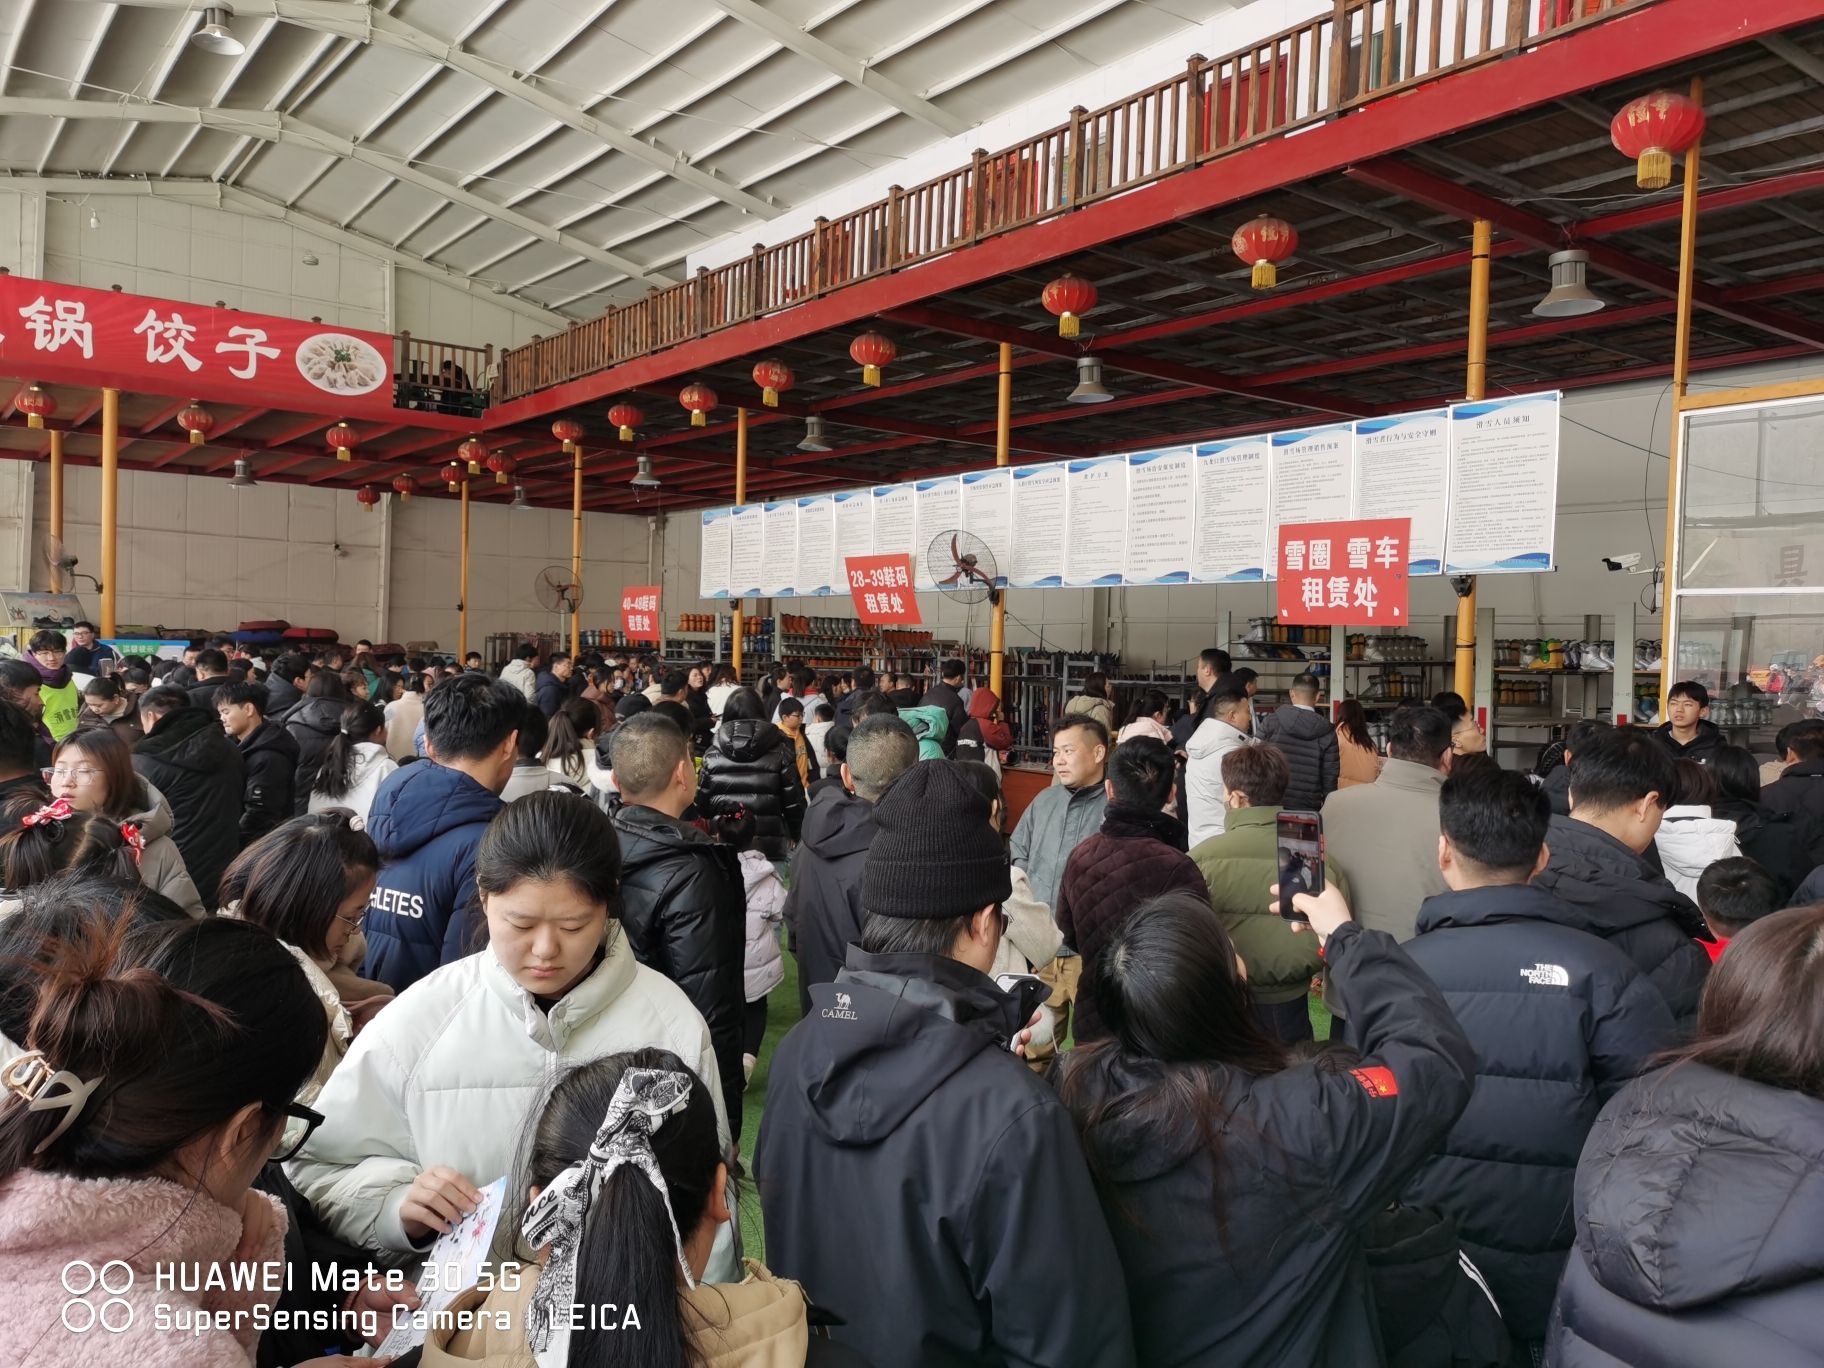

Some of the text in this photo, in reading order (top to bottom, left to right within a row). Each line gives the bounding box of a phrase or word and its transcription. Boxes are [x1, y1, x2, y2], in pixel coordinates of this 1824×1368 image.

[0, 295, 282, 380] 锅 饺子
[1284, 536, 1400, 571] 雪圈 雪车
[850, 566, 909, 588] 28-39鞋码
[864, 592, 905, 614] 租赁处
[1301, 576, 1378, 610] 租赁处
[628, 615, 651, 632] 租赁处
[369, 886, 423, 919] HLETES
[1520, 969, 1553, 978] NORTH
[1534, 963, 1553, 971] THE
[1528, 976, 1553, 985] FACE
[821, 1008, 858, 1020] CAMEL
